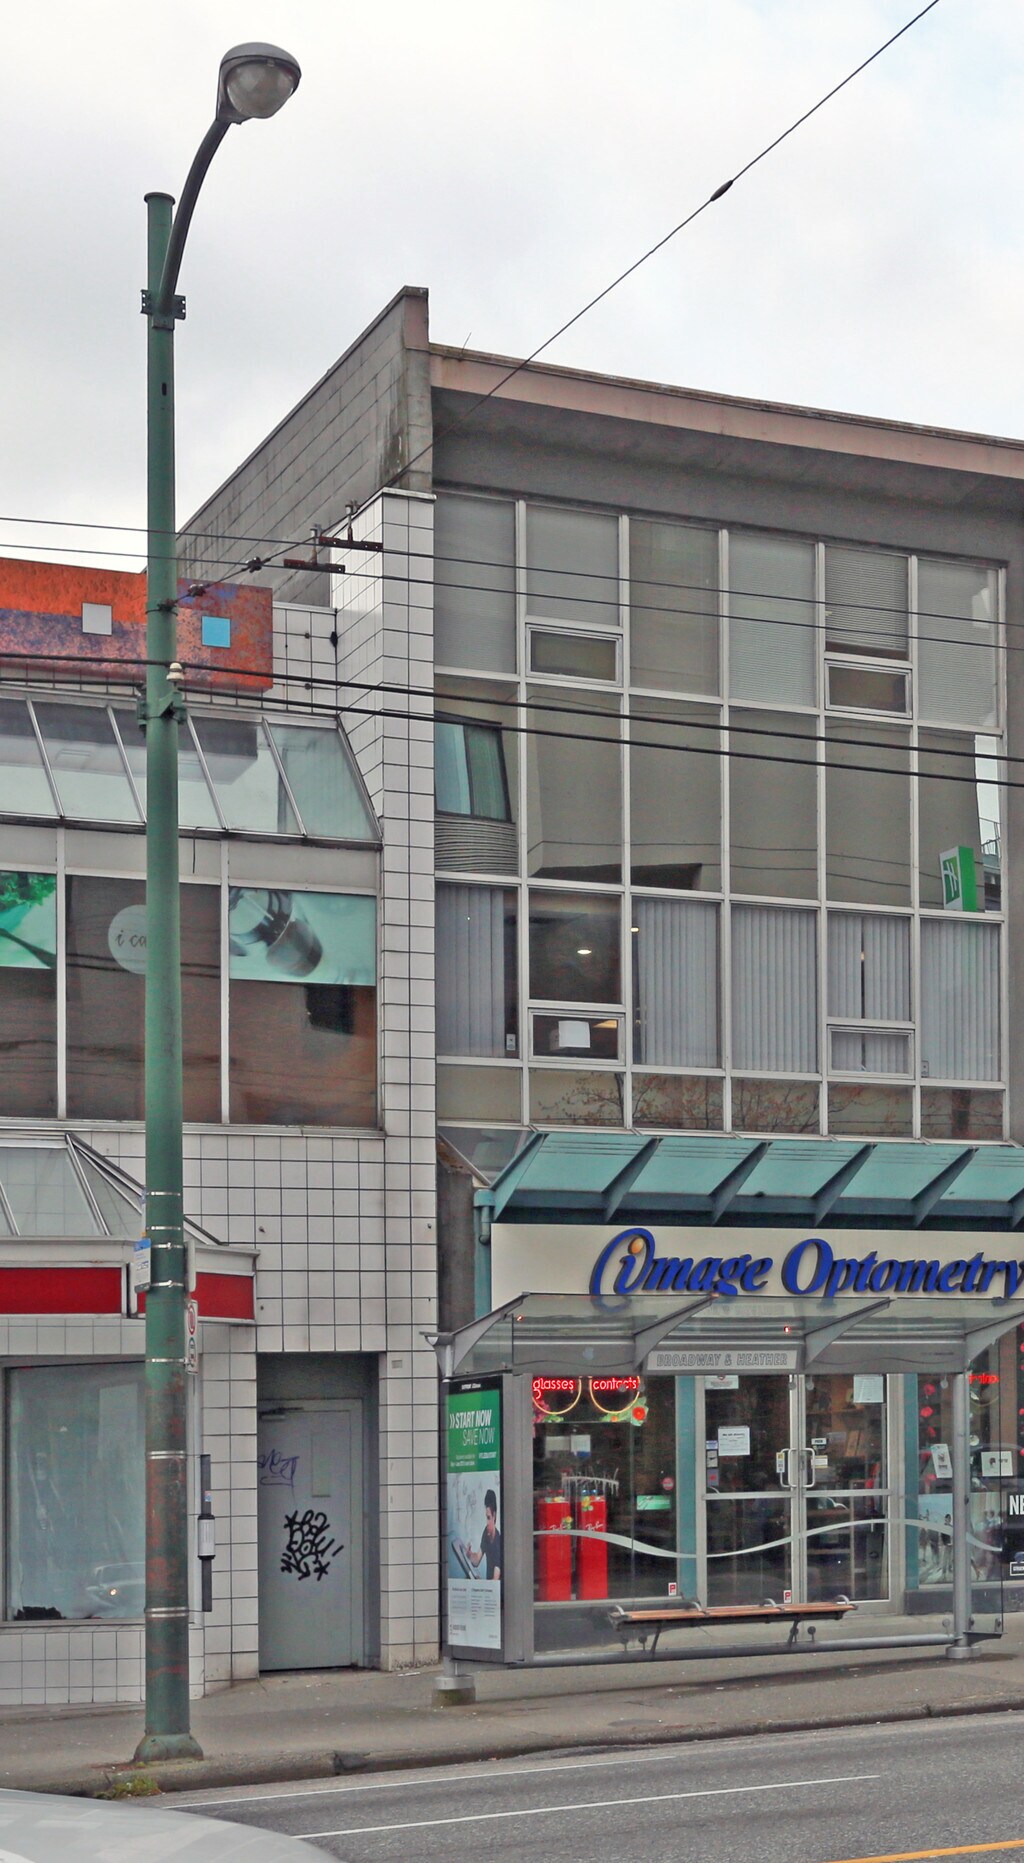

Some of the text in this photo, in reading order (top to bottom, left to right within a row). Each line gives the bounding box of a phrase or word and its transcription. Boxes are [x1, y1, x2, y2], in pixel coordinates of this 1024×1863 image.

[129, 934, 147, 948] ca
[656, 1353, 788, 1367] BROADWAY & HEATHER
[532, 1378, 574, 1399] glasses
[592, 1378, 637, 1390] contacts
[455, 1409, 492, 1429] START NOW
[462, 1427, 495, 1446] SAVE NOW
